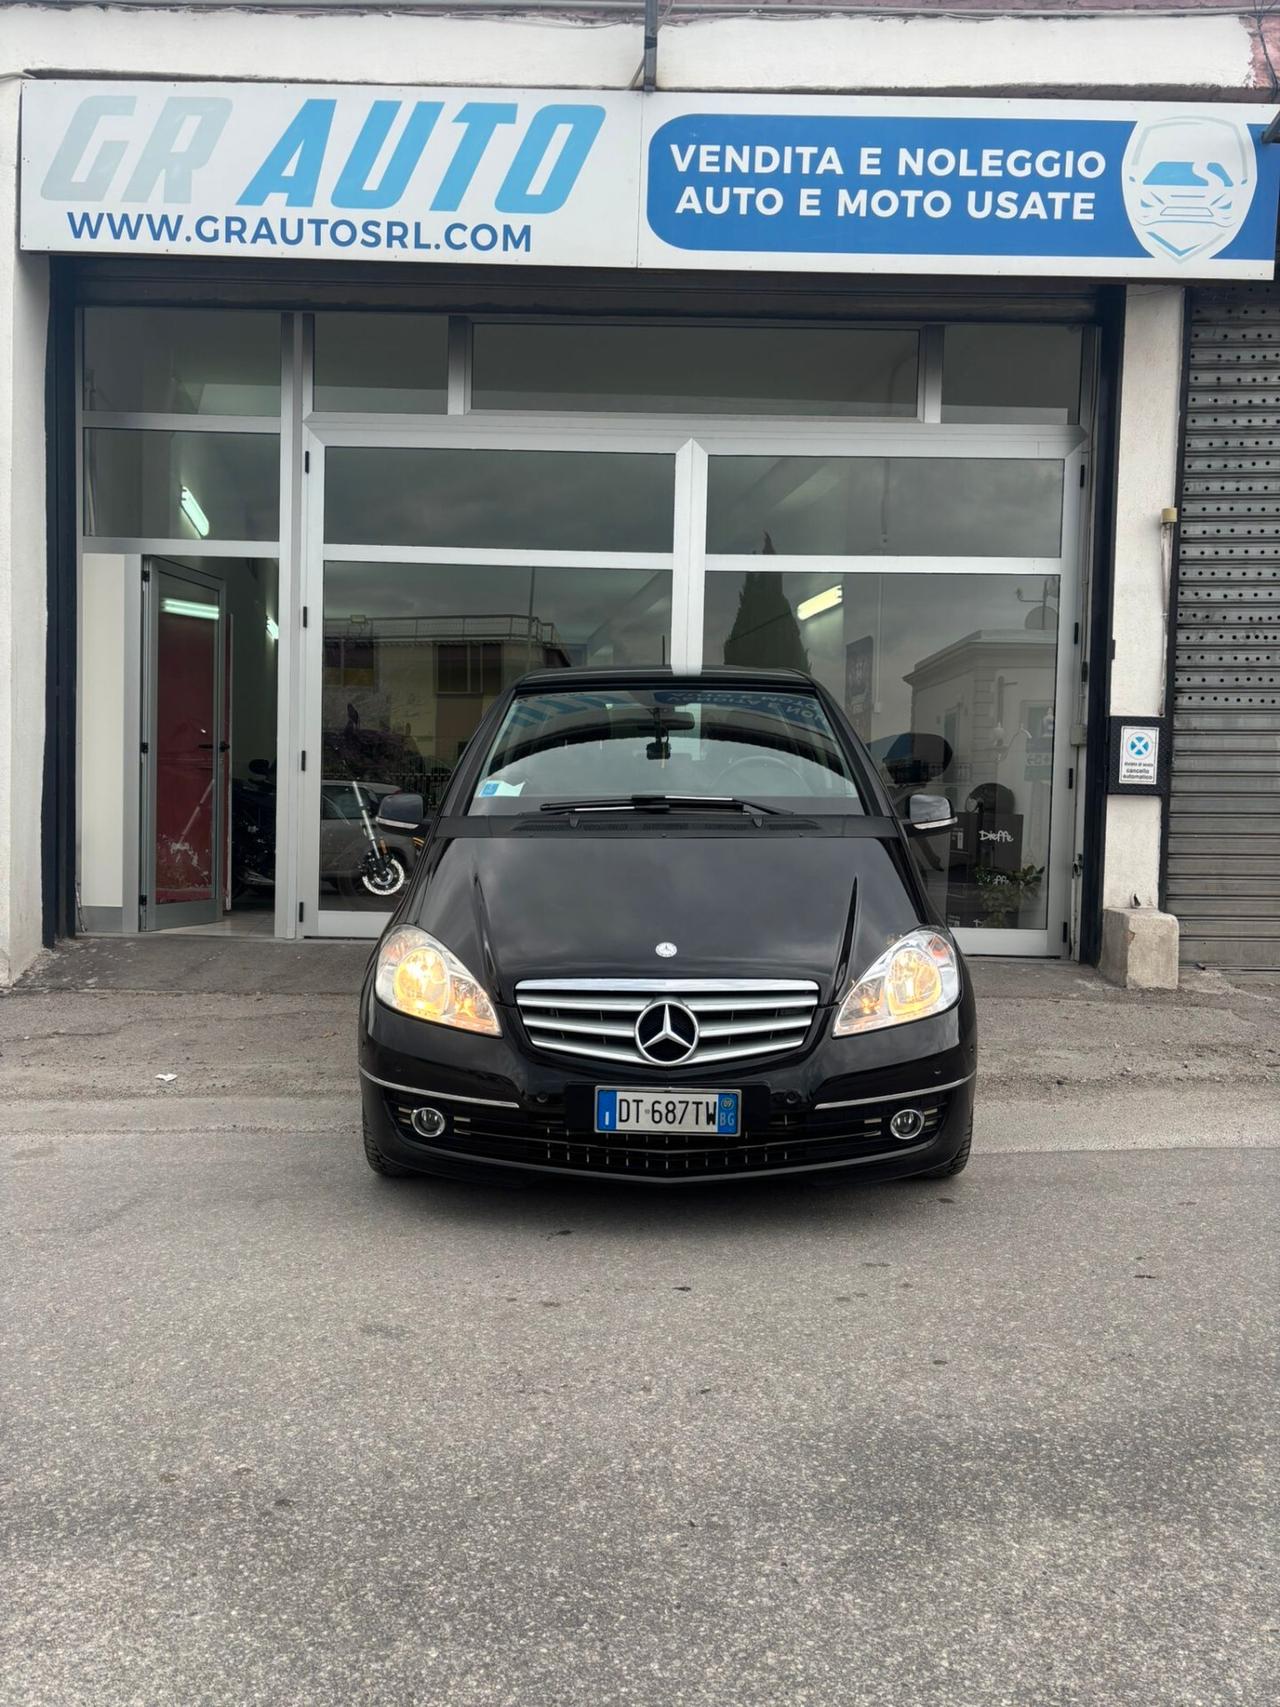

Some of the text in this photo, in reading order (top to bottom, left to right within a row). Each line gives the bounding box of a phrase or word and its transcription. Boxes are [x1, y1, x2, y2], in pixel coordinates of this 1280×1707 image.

[40, 95, 607, 215] GR AUTO
[670, 144, 1107, 180] VENDITA E NOLEGGIO
[675, 186, 1097, 221] AUTO E MOTO USATE
[67, 211, 532, 253] WWW.GRAUTOSRL.COM
[720, 1112, 735, 1127] BG
